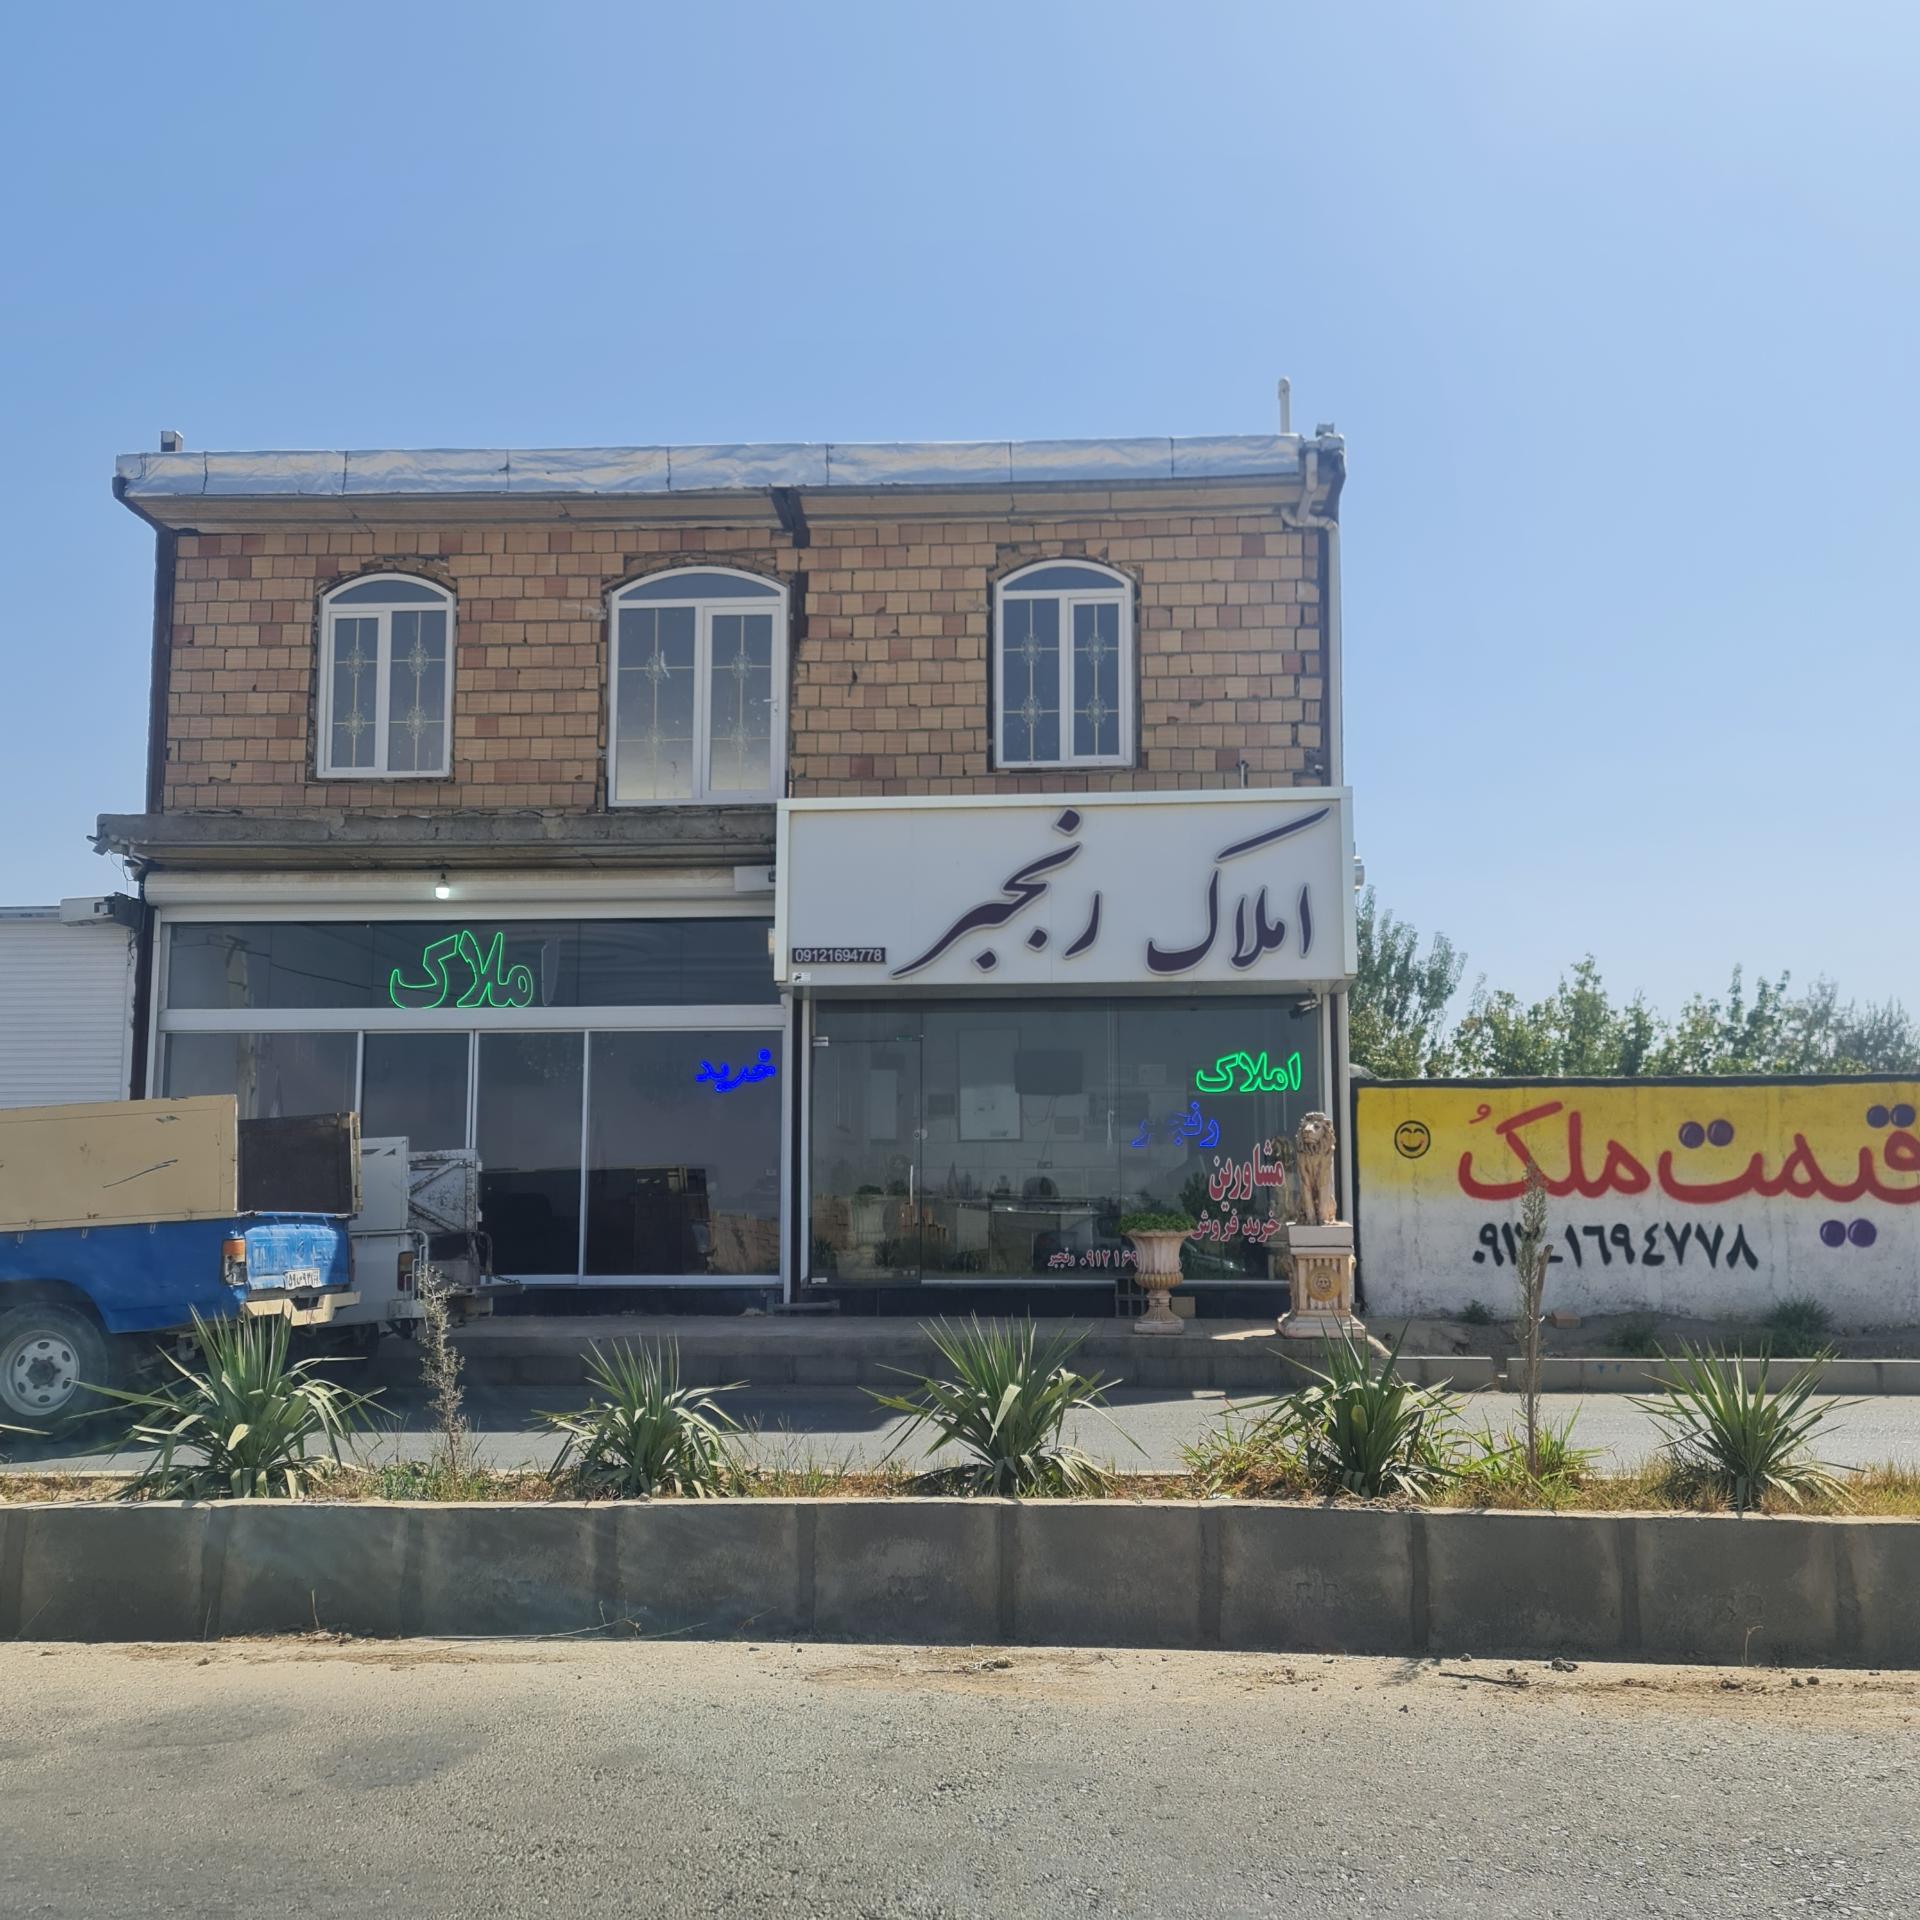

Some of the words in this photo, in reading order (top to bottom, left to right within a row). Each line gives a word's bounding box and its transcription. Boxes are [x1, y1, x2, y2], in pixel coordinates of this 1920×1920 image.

[890, 807, 1103, 979] رنجبر
[1146, 805, 1332, 975] املاک
[795, 948, 882, 962] 09121694778
[1195, 1051, 1301, 1094] املاک
[1208, 1139, 1286, 1212] مشاورین
[1657, 1103, 1920, 1248] قیمت
[1190, 1208, 1241, 1243] فروش
[1241, 1209, 1282, 1244] خرید
